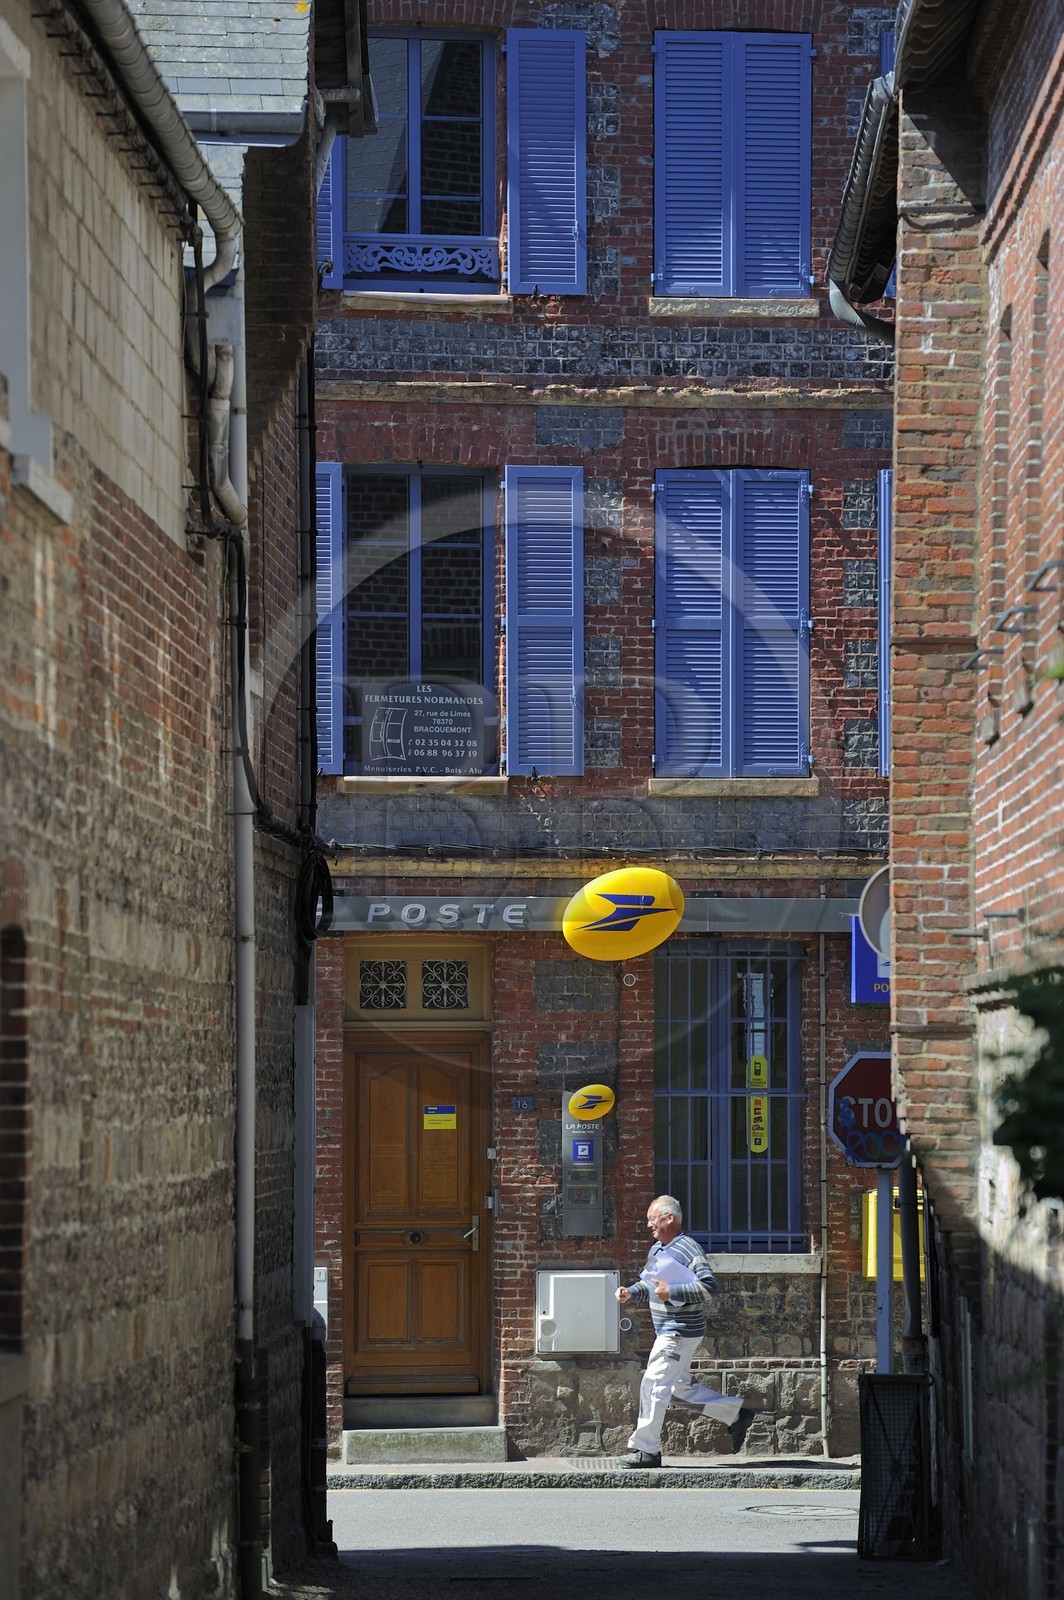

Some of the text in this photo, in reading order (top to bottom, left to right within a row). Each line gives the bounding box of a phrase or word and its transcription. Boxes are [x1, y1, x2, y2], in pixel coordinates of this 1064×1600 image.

[365, 695, 484, 704] FERMETURES NORMANDES
[366, 903, 528, 925] POSTE
[874, 983, 890, 993] PO
[516, 1100, 528, 1109] 16
[838, 1096, 900, 1128] STO
